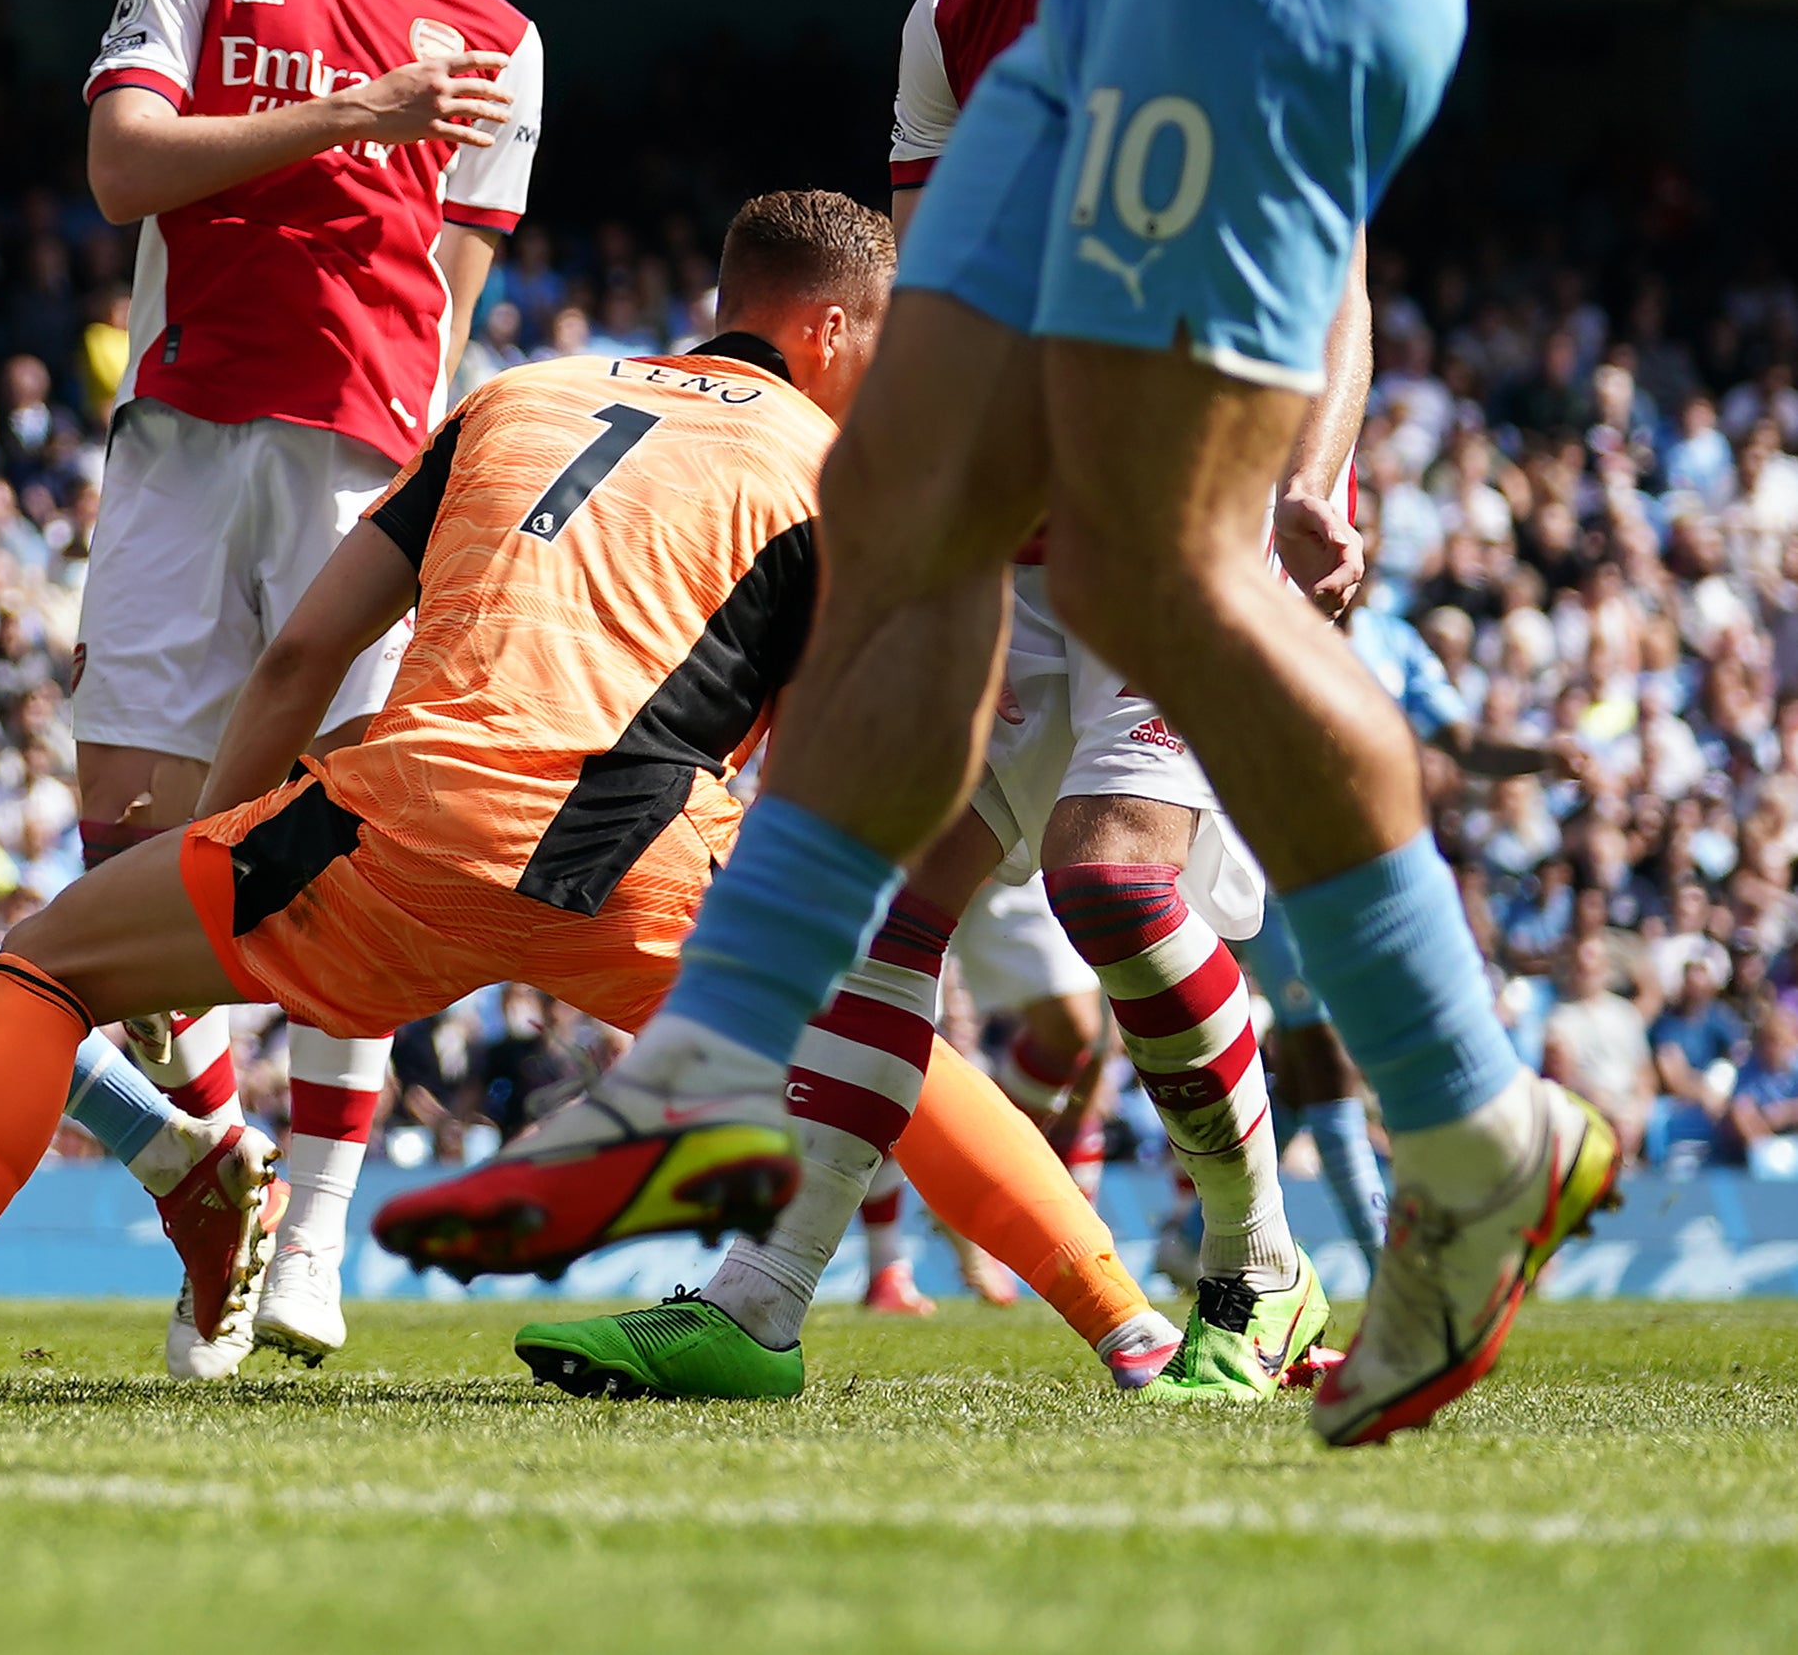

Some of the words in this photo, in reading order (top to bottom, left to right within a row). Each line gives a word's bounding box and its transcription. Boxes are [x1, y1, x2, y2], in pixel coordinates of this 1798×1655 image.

[1070, 87, 1213, 241] 10
[609, 359, 763, 405] LENO
[518, 402, 663, 544] 1
[1129, 730, 1187, 755] adidas
